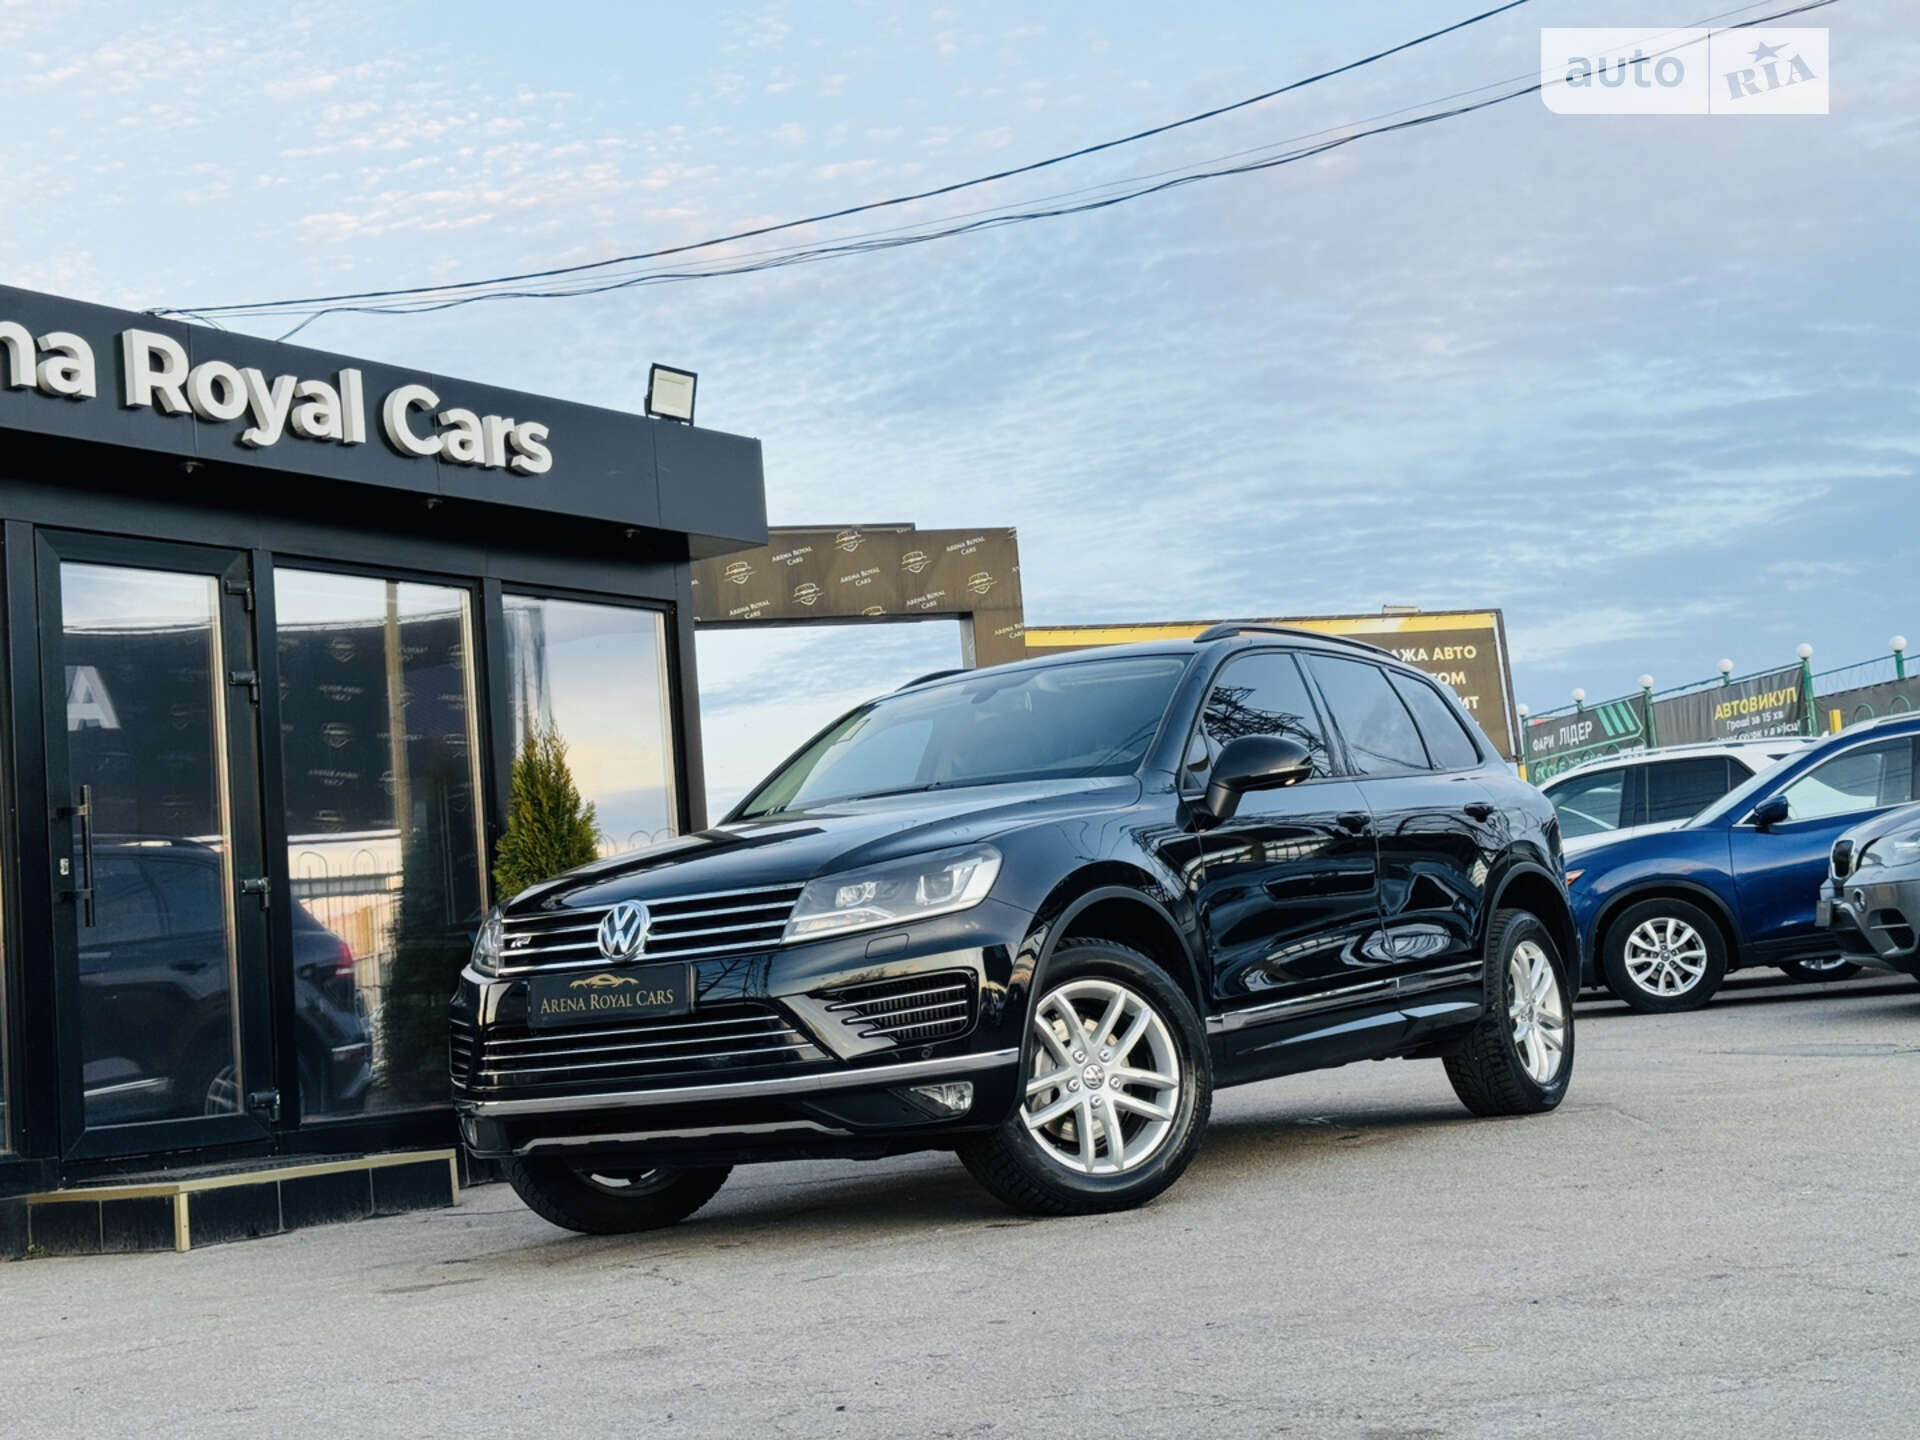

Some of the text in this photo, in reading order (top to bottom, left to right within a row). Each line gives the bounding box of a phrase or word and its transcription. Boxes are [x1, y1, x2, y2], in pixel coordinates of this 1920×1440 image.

[121, 328, 366, 448] Royal
[382, 383, 553, 476] Cars
[1433, 645, 1477, 661] АВТО
[1714, 686, 1798, 720] АВТОВИКУП
[1762, 711, 1772, 723] 15
[1532, 721, 1593, 752] ФАРИ ЛІДЕР
[540, 989, 674, 1014] ARENA ROYAL CARS
